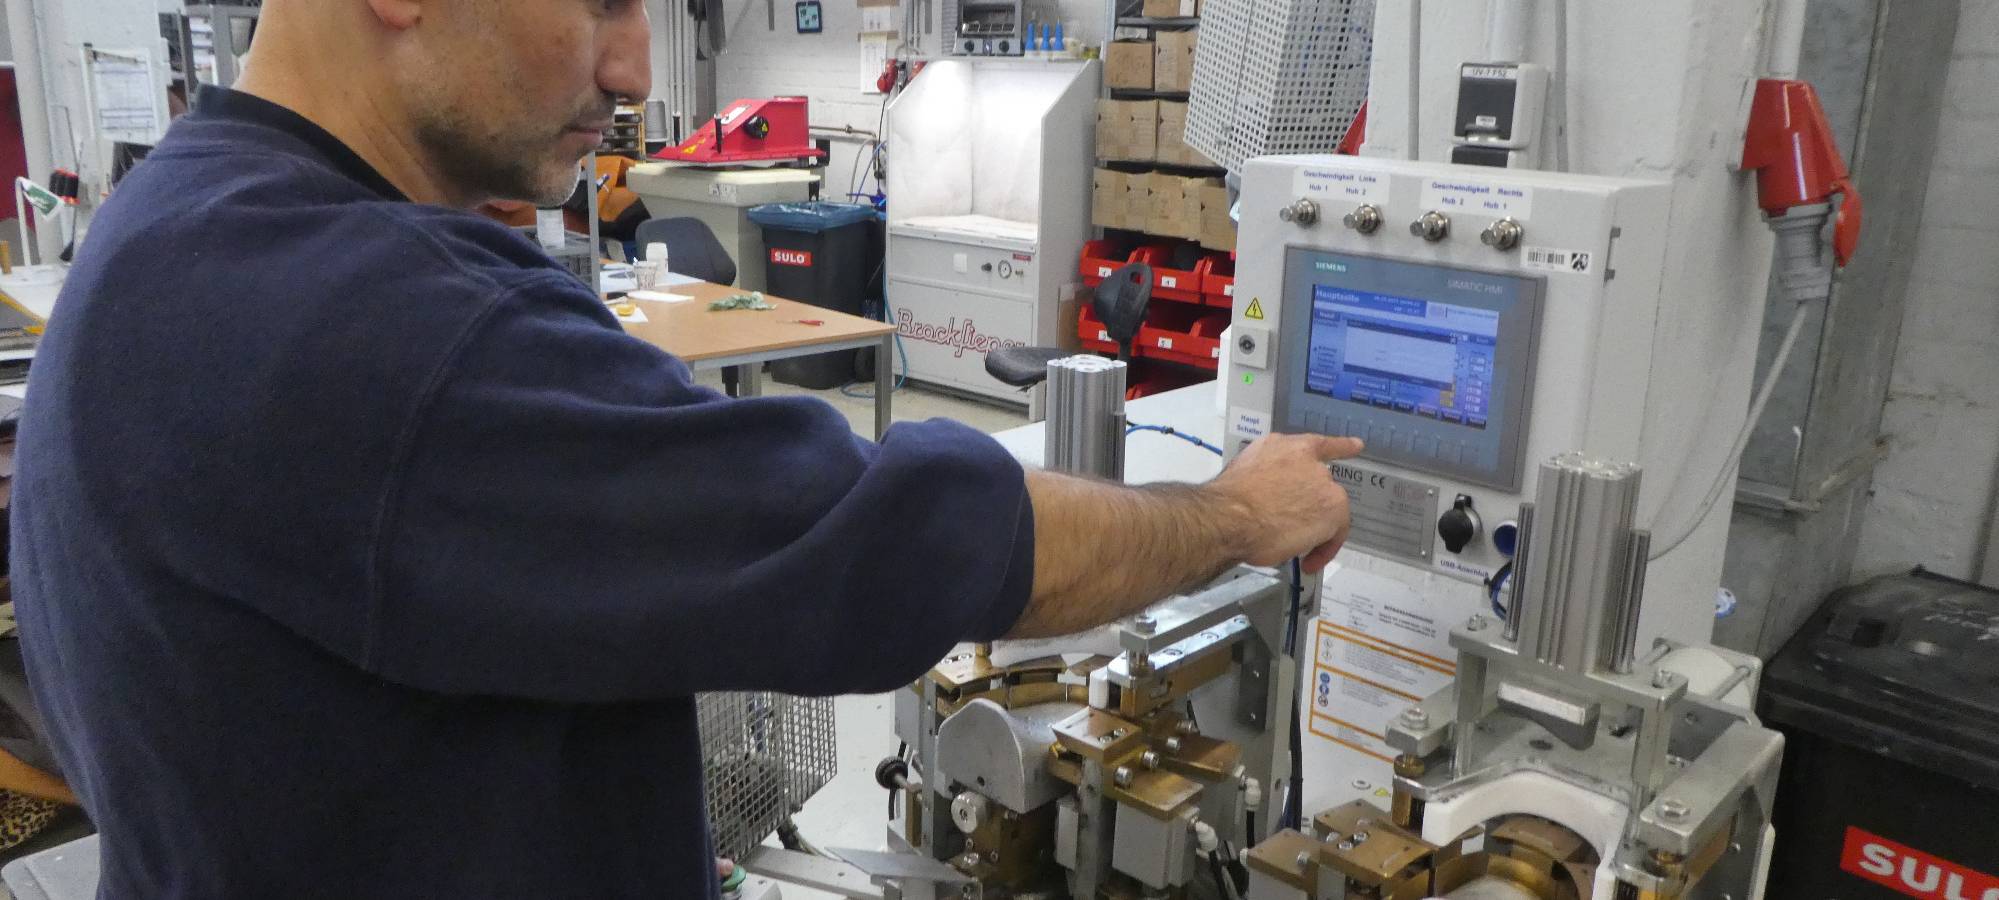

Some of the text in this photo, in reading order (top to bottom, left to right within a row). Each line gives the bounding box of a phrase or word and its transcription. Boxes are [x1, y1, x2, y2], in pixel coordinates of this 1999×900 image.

[1309, 183, 1322, 192] Hub
[1345, 187, 1359, 195] Hub
[1431, 182, 1523, 198] Geschwindigkeit Rechts
[1441, 196, 1456, 205] Hub
[1483, 201, 1499, 209] Hub
[774, 251, 805, 264] SULO
[1315, 261, 1347, 273] SIEMENS
[1240, 414, 1260, 426] Haupt
[1329, 463, 1363, 483] RING
